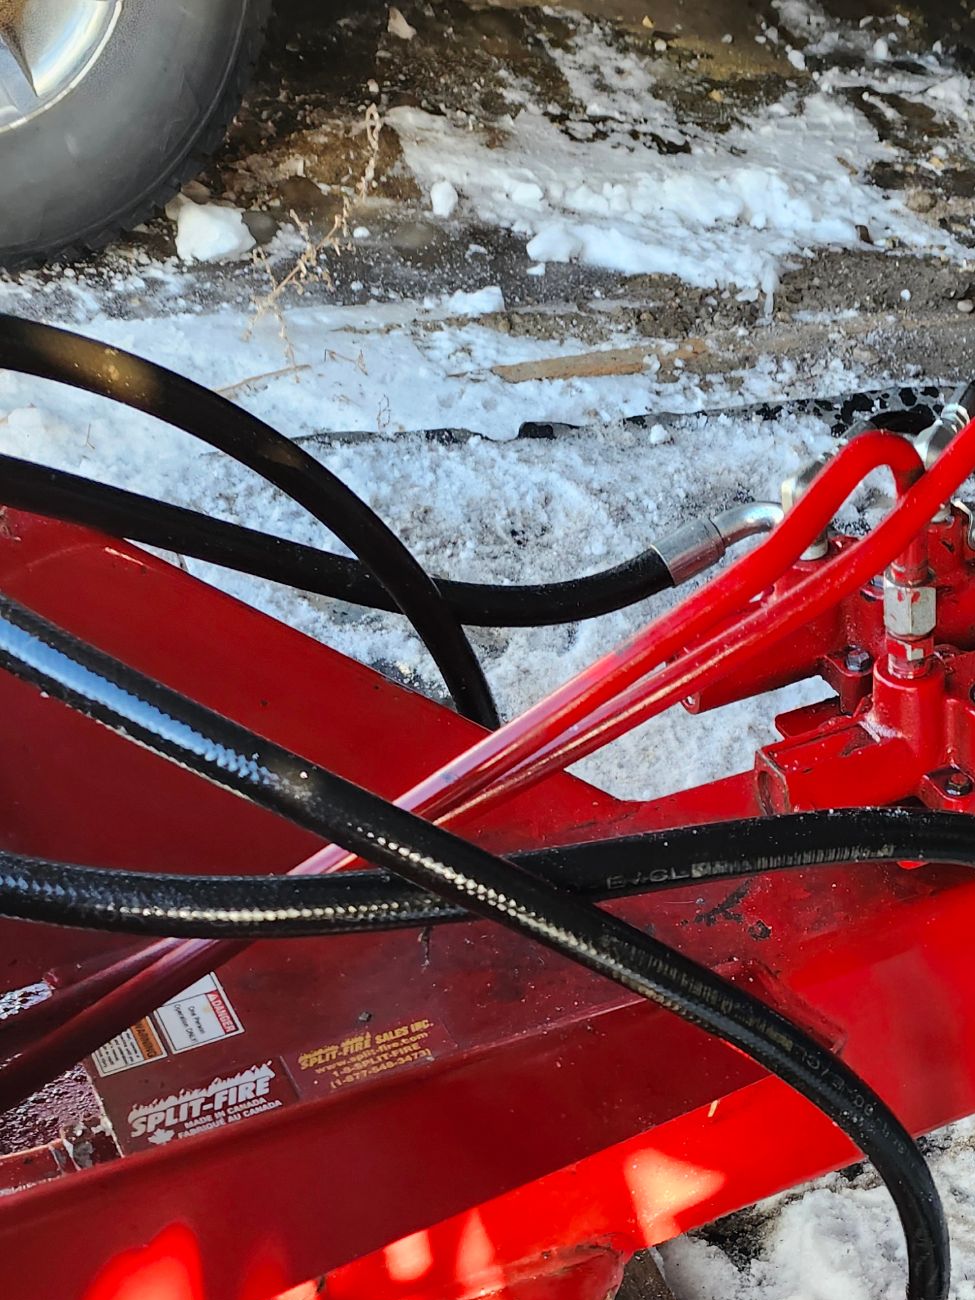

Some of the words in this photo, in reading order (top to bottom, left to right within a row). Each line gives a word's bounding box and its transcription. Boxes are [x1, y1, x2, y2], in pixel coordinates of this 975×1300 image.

[211, 999, 238, 1033] DANGER
[299, 1039, 371, 1070] SPLIT-FIRE
[375, 1025, 409, 1044] SALES
[410, 1019, 434, 1032] INC.
[315, 1032, 429, 1074] www.split-fire.com
[130, 1076, 270, 1138] SPLIT-FIRE
[184, 1114, 213, 1129] MADE
[215, 1111, 225, 1120] IN
[227, 1097, 267, 1114] CANADA
[228, 1113, 241, 1124] AU
[243, 1099, 282, 1117] CANADA
